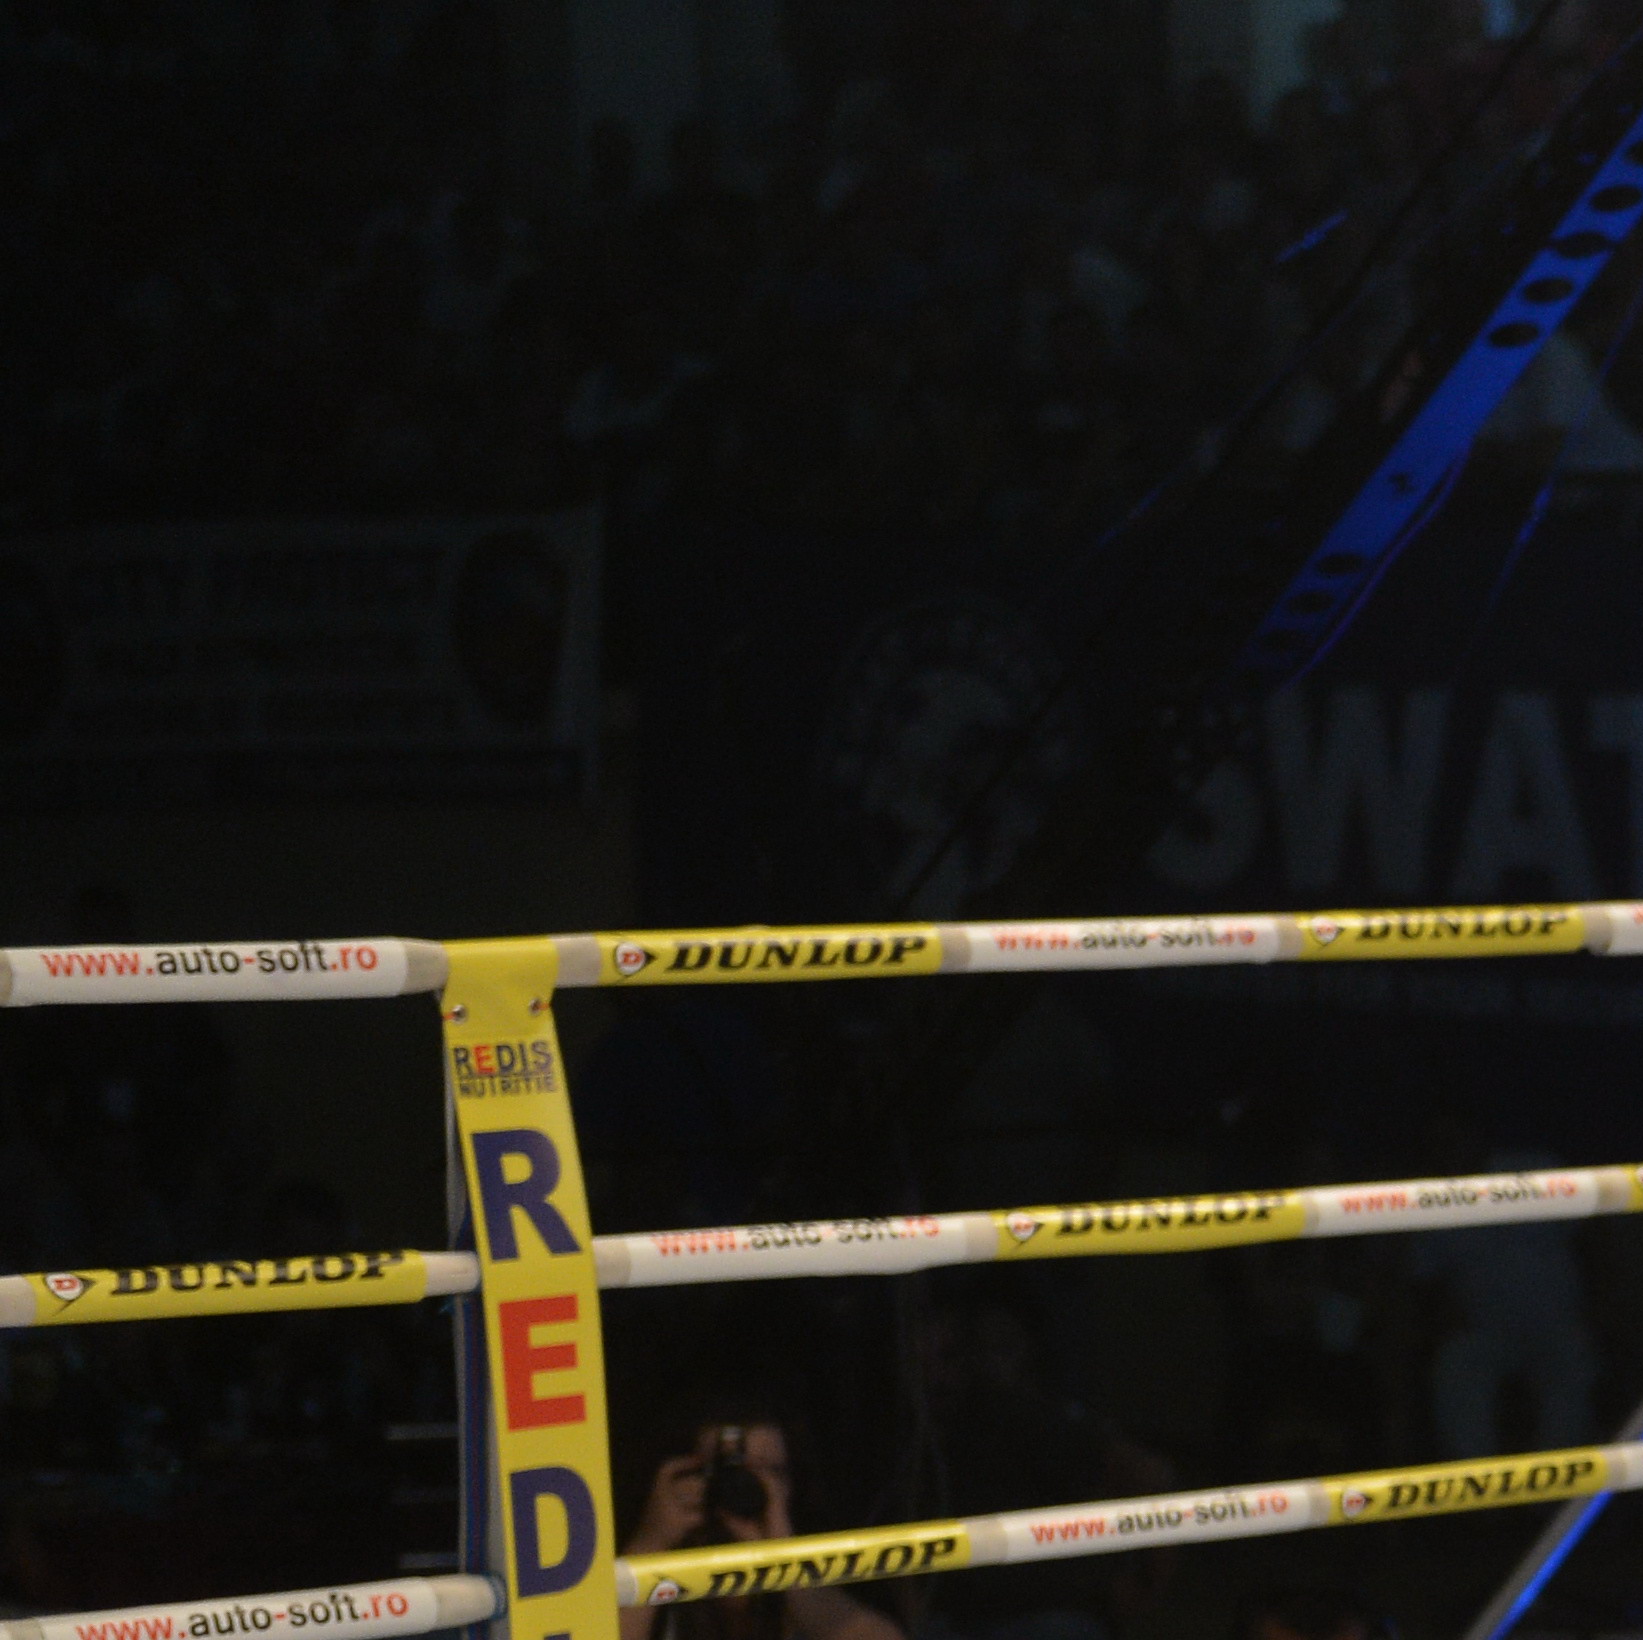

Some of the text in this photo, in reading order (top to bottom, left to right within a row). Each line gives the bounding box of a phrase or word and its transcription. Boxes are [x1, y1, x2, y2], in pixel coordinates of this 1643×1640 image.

[994, 919, 1258, 953] www.auto-soft.ro
[1355, 909, 1571, 940] DUNLOP
[43, 937, 379, 978] www.auto-soft.ro
[663, 935, 927, 973] DUNLOP
[453, 1040, 553, 1078] REDIS
[1055, 1191, 1288, 1237] DUNLOP
[1340, 1176, 1577, 1216] www.auto-soft.ro
[651, 1213, 941, 1258] www.auto-soft.ro
[110, 1252, 407, 1297] DUNLOP
[1386, 1459, 1595, 1511] DUNLOP
[1031, 1488, 1288, 1546] www.auto-soft.ro
[707, 1536, 957, 1597] DUNLOP
